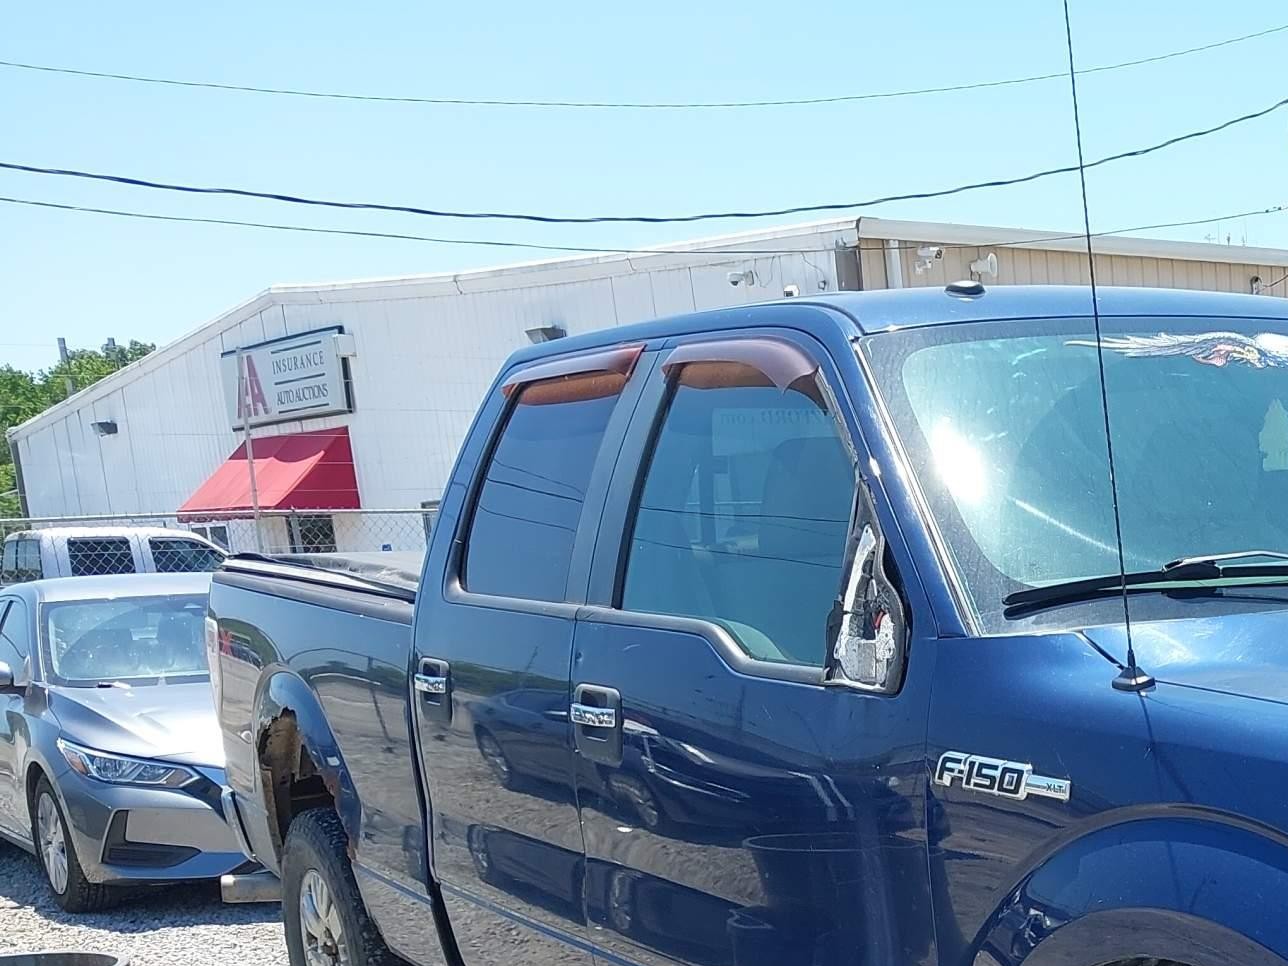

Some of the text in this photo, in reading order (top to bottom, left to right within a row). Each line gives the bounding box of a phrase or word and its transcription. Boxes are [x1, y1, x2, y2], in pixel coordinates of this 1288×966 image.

[272, 351, 324, 375] INSURANCE
[277, 384, 328, 405] AUTO AUCTIONS
[1046, 782, 1064, 793] XLT
